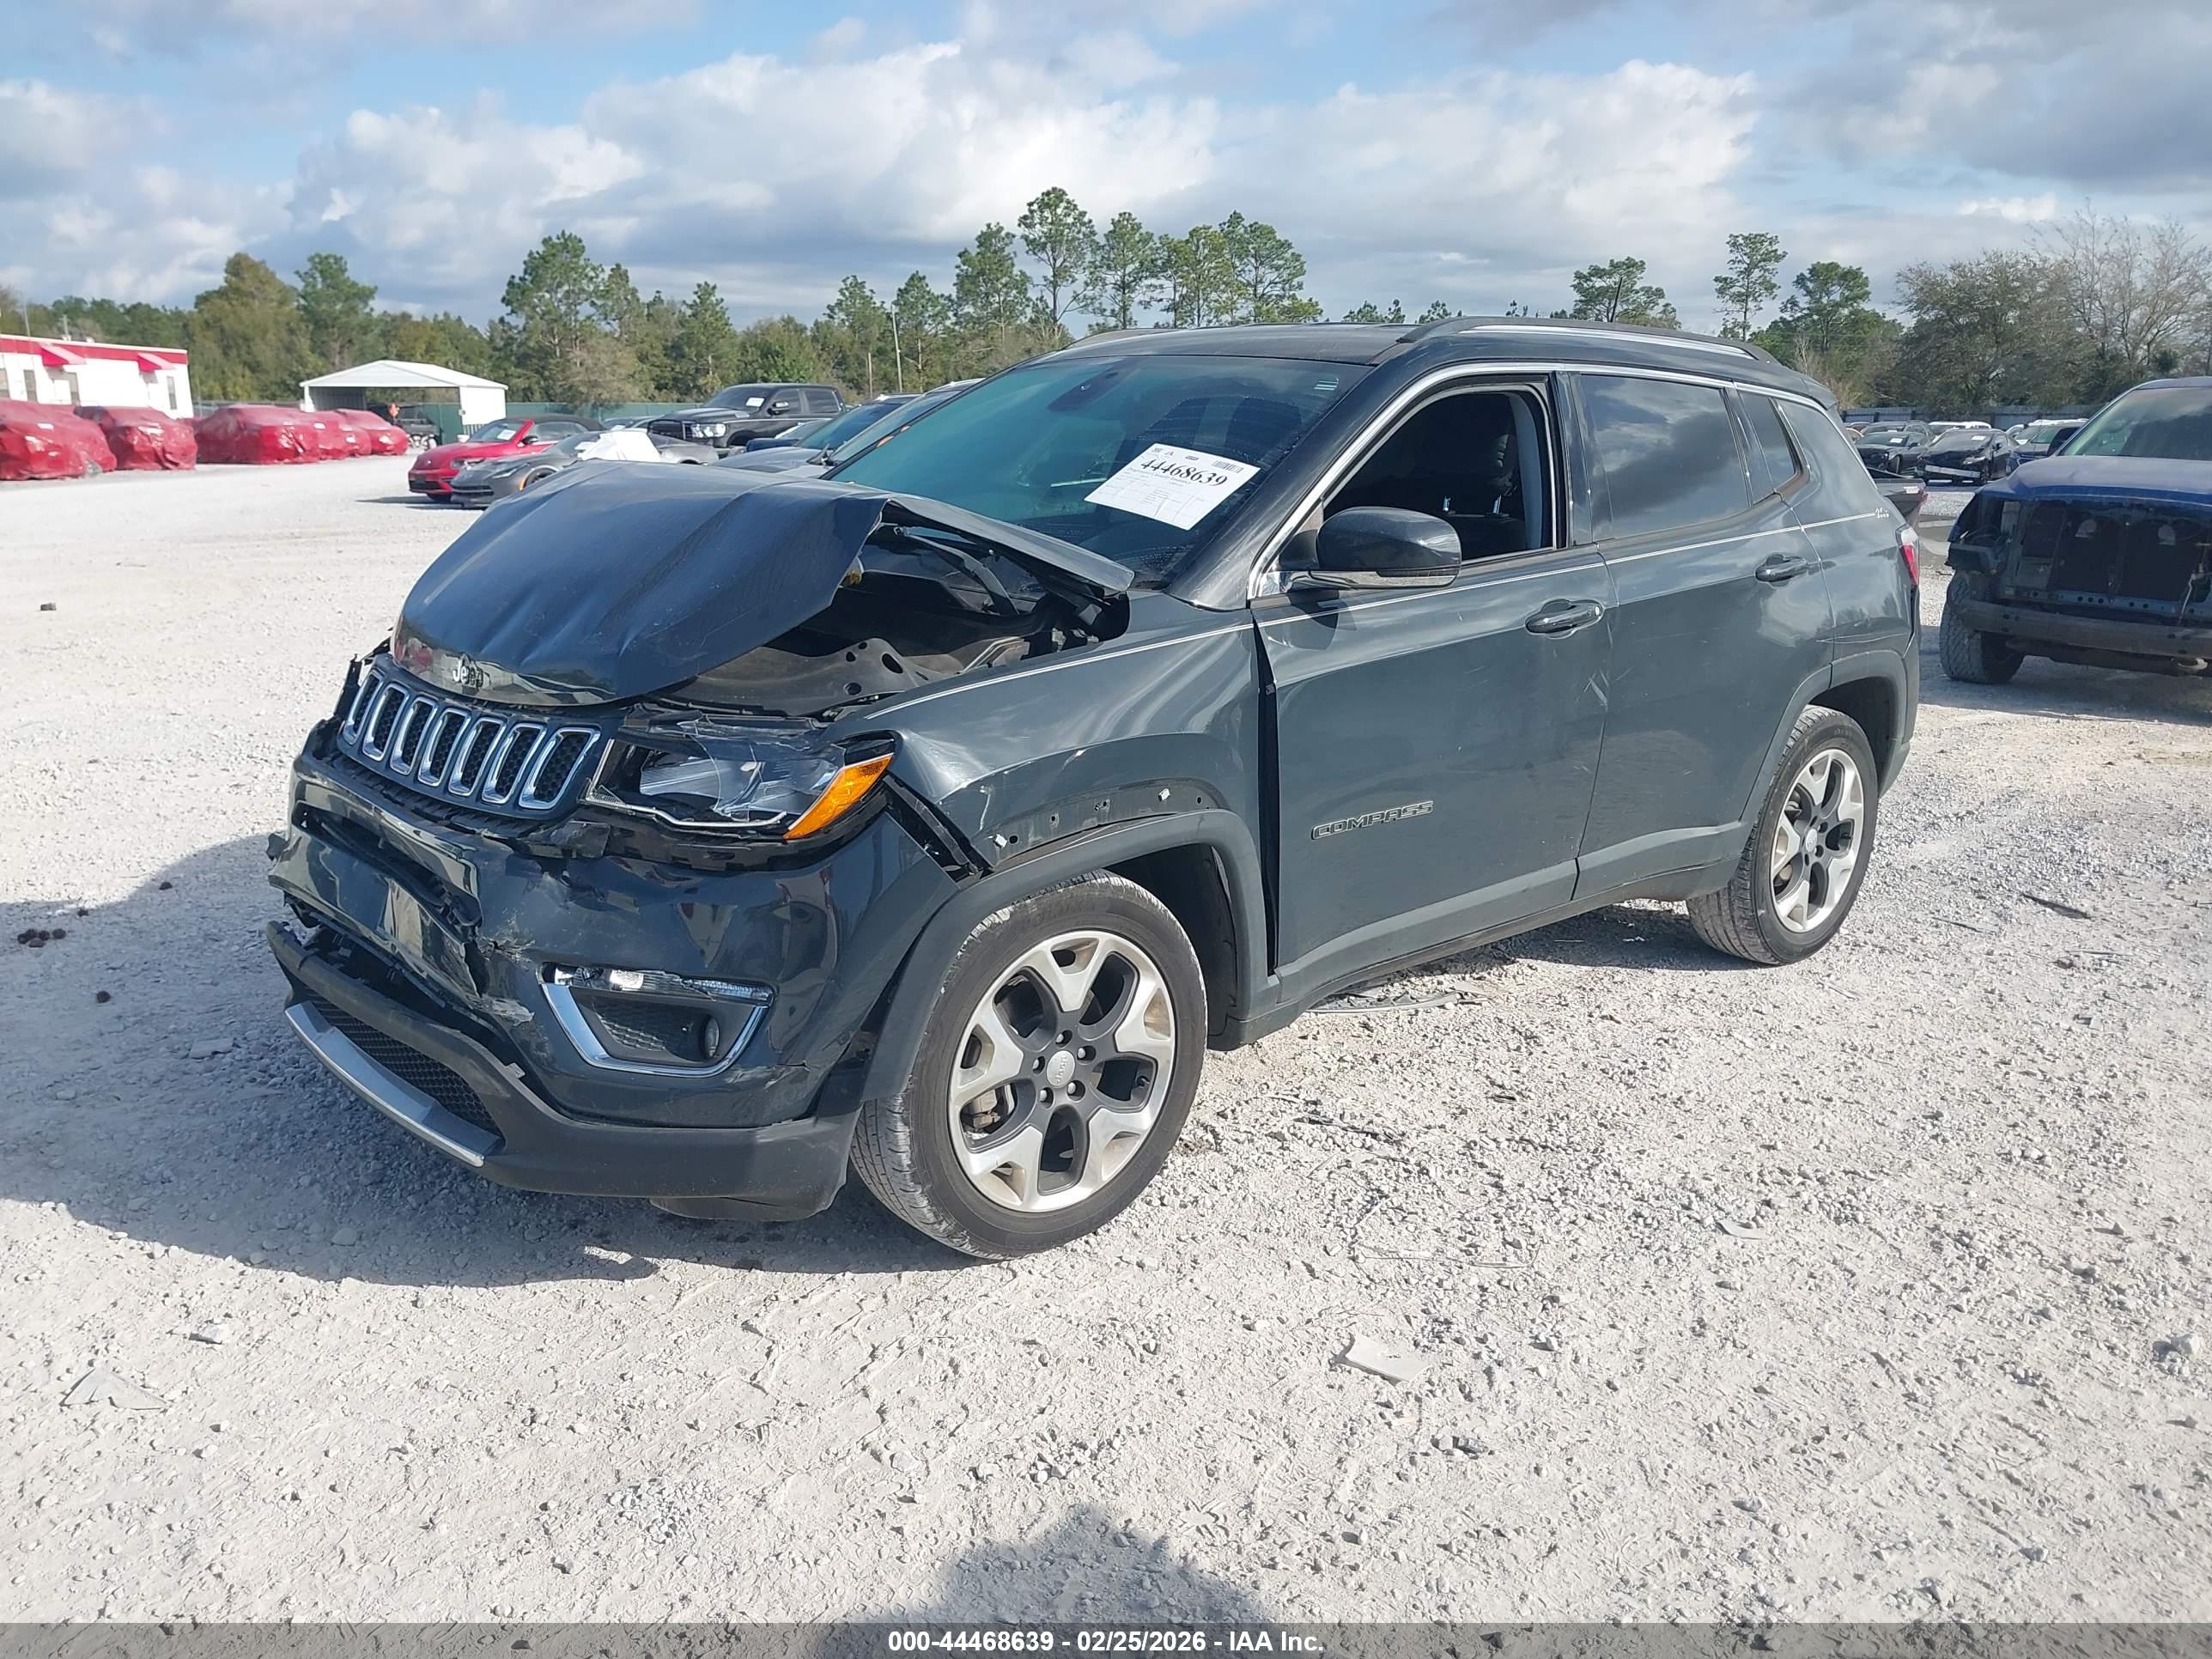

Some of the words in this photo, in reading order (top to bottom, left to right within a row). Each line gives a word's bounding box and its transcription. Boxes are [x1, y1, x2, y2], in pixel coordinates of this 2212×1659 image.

[1140, 459, 1228, 486] 44468639
[453, 659, 483, 692] Jeep
[1311, 800, 1434, 840] COMPASS
